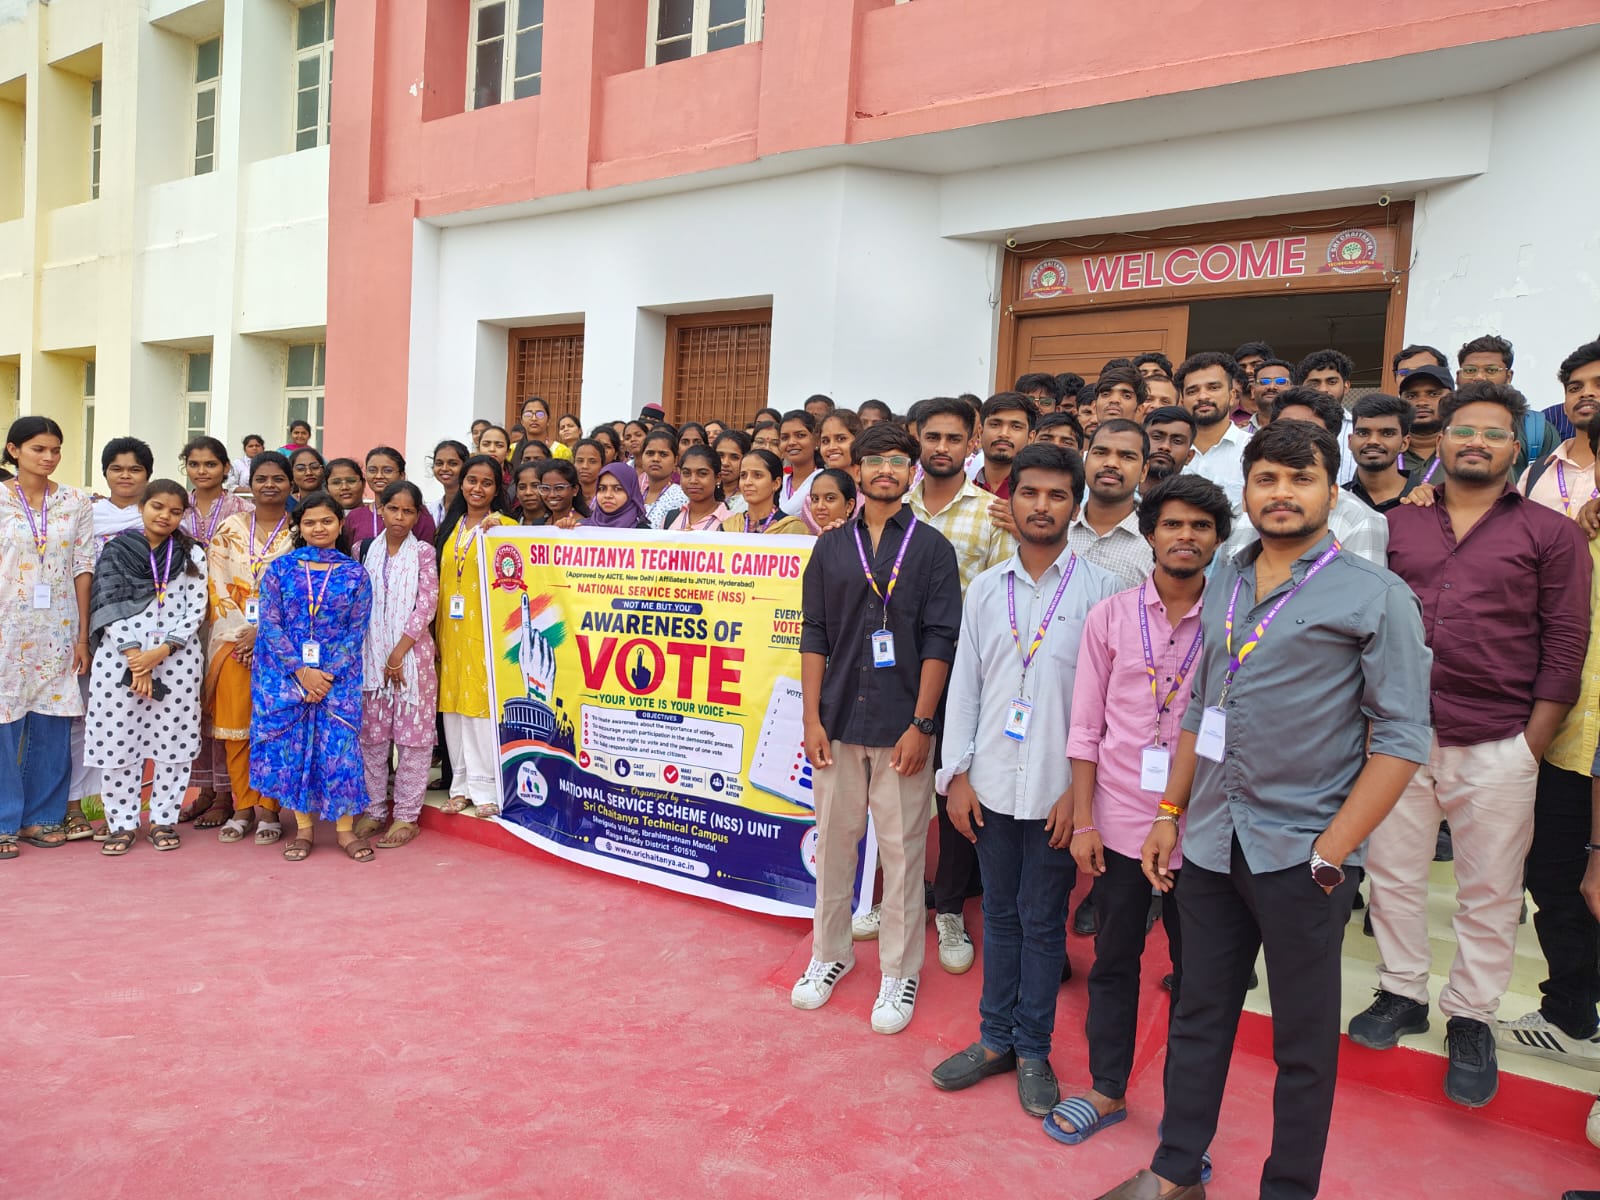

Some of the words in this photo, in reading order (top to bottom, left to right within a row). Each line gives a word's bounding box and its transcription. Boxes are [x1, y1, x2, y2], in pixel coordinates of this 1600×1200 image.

[1082, 236, 1306, 292] WELCOME
[530, 544, 550, 565] SRI
[554, 545, 635, 569] CHAITANYA
[640, 549, 726, 574] TECHNICAL
[732, 552, 800, 578] CAMPUS
[566, 570, 596, 578] (Approved
[658, 576, 687, 584] Affiliated
[719, 580, 754, 588] Hyderabad)
[578, 583, 624, 595] NATIONAL
[628, 586, 670, 598] SERVICE
[674, 588, 714, 600] SCHEME
[718, 590, 746, 604] (NSS)
[656, 602, 672, 611] BUT
[774, 608, 802, 620] EVERY
[580, 611, 708, 640] AWARENESS
[714, 620, 742, 642] OF
[773, 620, 800, 634] VOTE
[771, 634, 800, 645] COUNTS
[576, 634, 745, 706] VOTE
[600, 694, 626, 706] YOUR
[629, 696, 655, 708] VOTE
[658, 698, 667, 709] IS
[671, 700, 695, 714] YOUR
[698, 704, 724, 717] VOICE
[642, 712, 677, 721] OBJECTIVES
[639, 730, 670, 738] participation
[686, 736, 713, 745] democratic
[665, 724, 692, 733] importance
[631, 786, 668, 800] Organized
[670, 792, 679, 805] by
[560, 778, 605, 802] NATIONAL
[607, 793, 654, 814] SERVICE
[658, 802, 707, 824] SCHEME
[710, 812, 743, 835] (NSS)
[748, 821, 781, 839] UNIT
[584, 801, 596, 812] Sri
[598, 805, 639, 825] Chaitanya
[642, 816, 688, 834] Technical
[691, 826, 728, 844] Campus
[606, 830, 624, 841] Ranga
[624, 835, 644, 846] Reddy
[645, 840, 669, 851] District
[642, 830, 691, 846] Ibrahimpatnam
[615, 844, 694, 871] www.srichaitanya.ac.in
